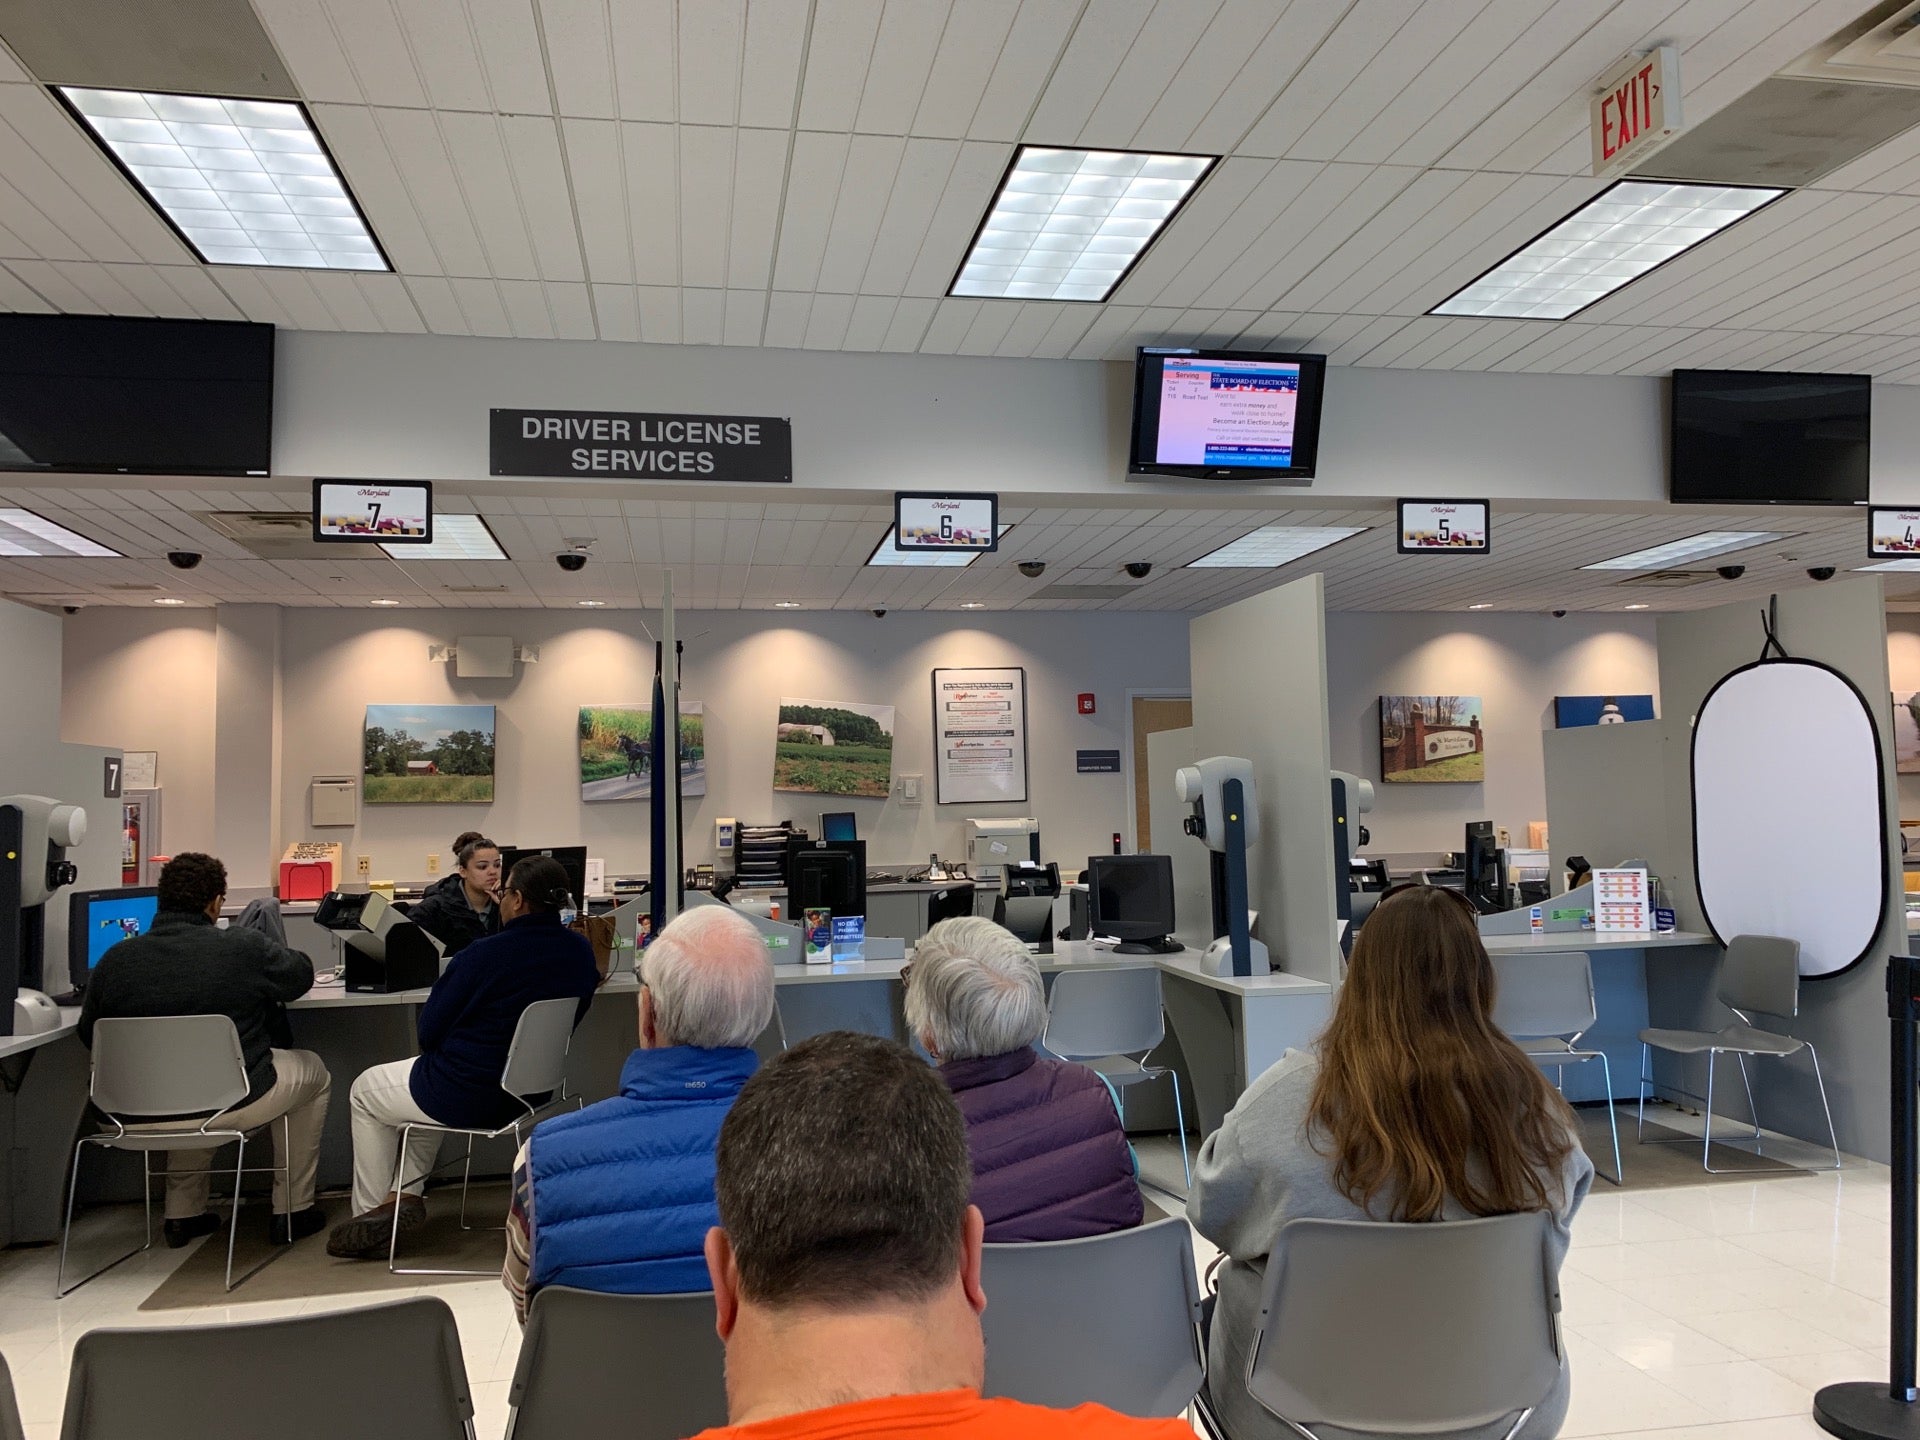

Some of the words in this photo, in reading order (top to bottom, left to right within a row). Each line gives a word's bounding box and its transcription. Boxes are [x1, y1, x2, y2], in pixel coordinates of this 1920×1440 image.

[1602, 63, 1652, 160] EXIT
[522, 417, 630, 441] DRIVER
[640, 421, 761, 445] LICENSE
[572, 448, 714, 473] SERVICES
[358, 489, 391, 498] Maryland
[368, 503, 381, 529] 7
[932, 502, 960, 510] Maryland
[941, 515, 952, 538] 6
[1439, 519, 1449, 540] 5
[1904, 526, 1914, 546] 4
[110, 764, 118, 791] 7
